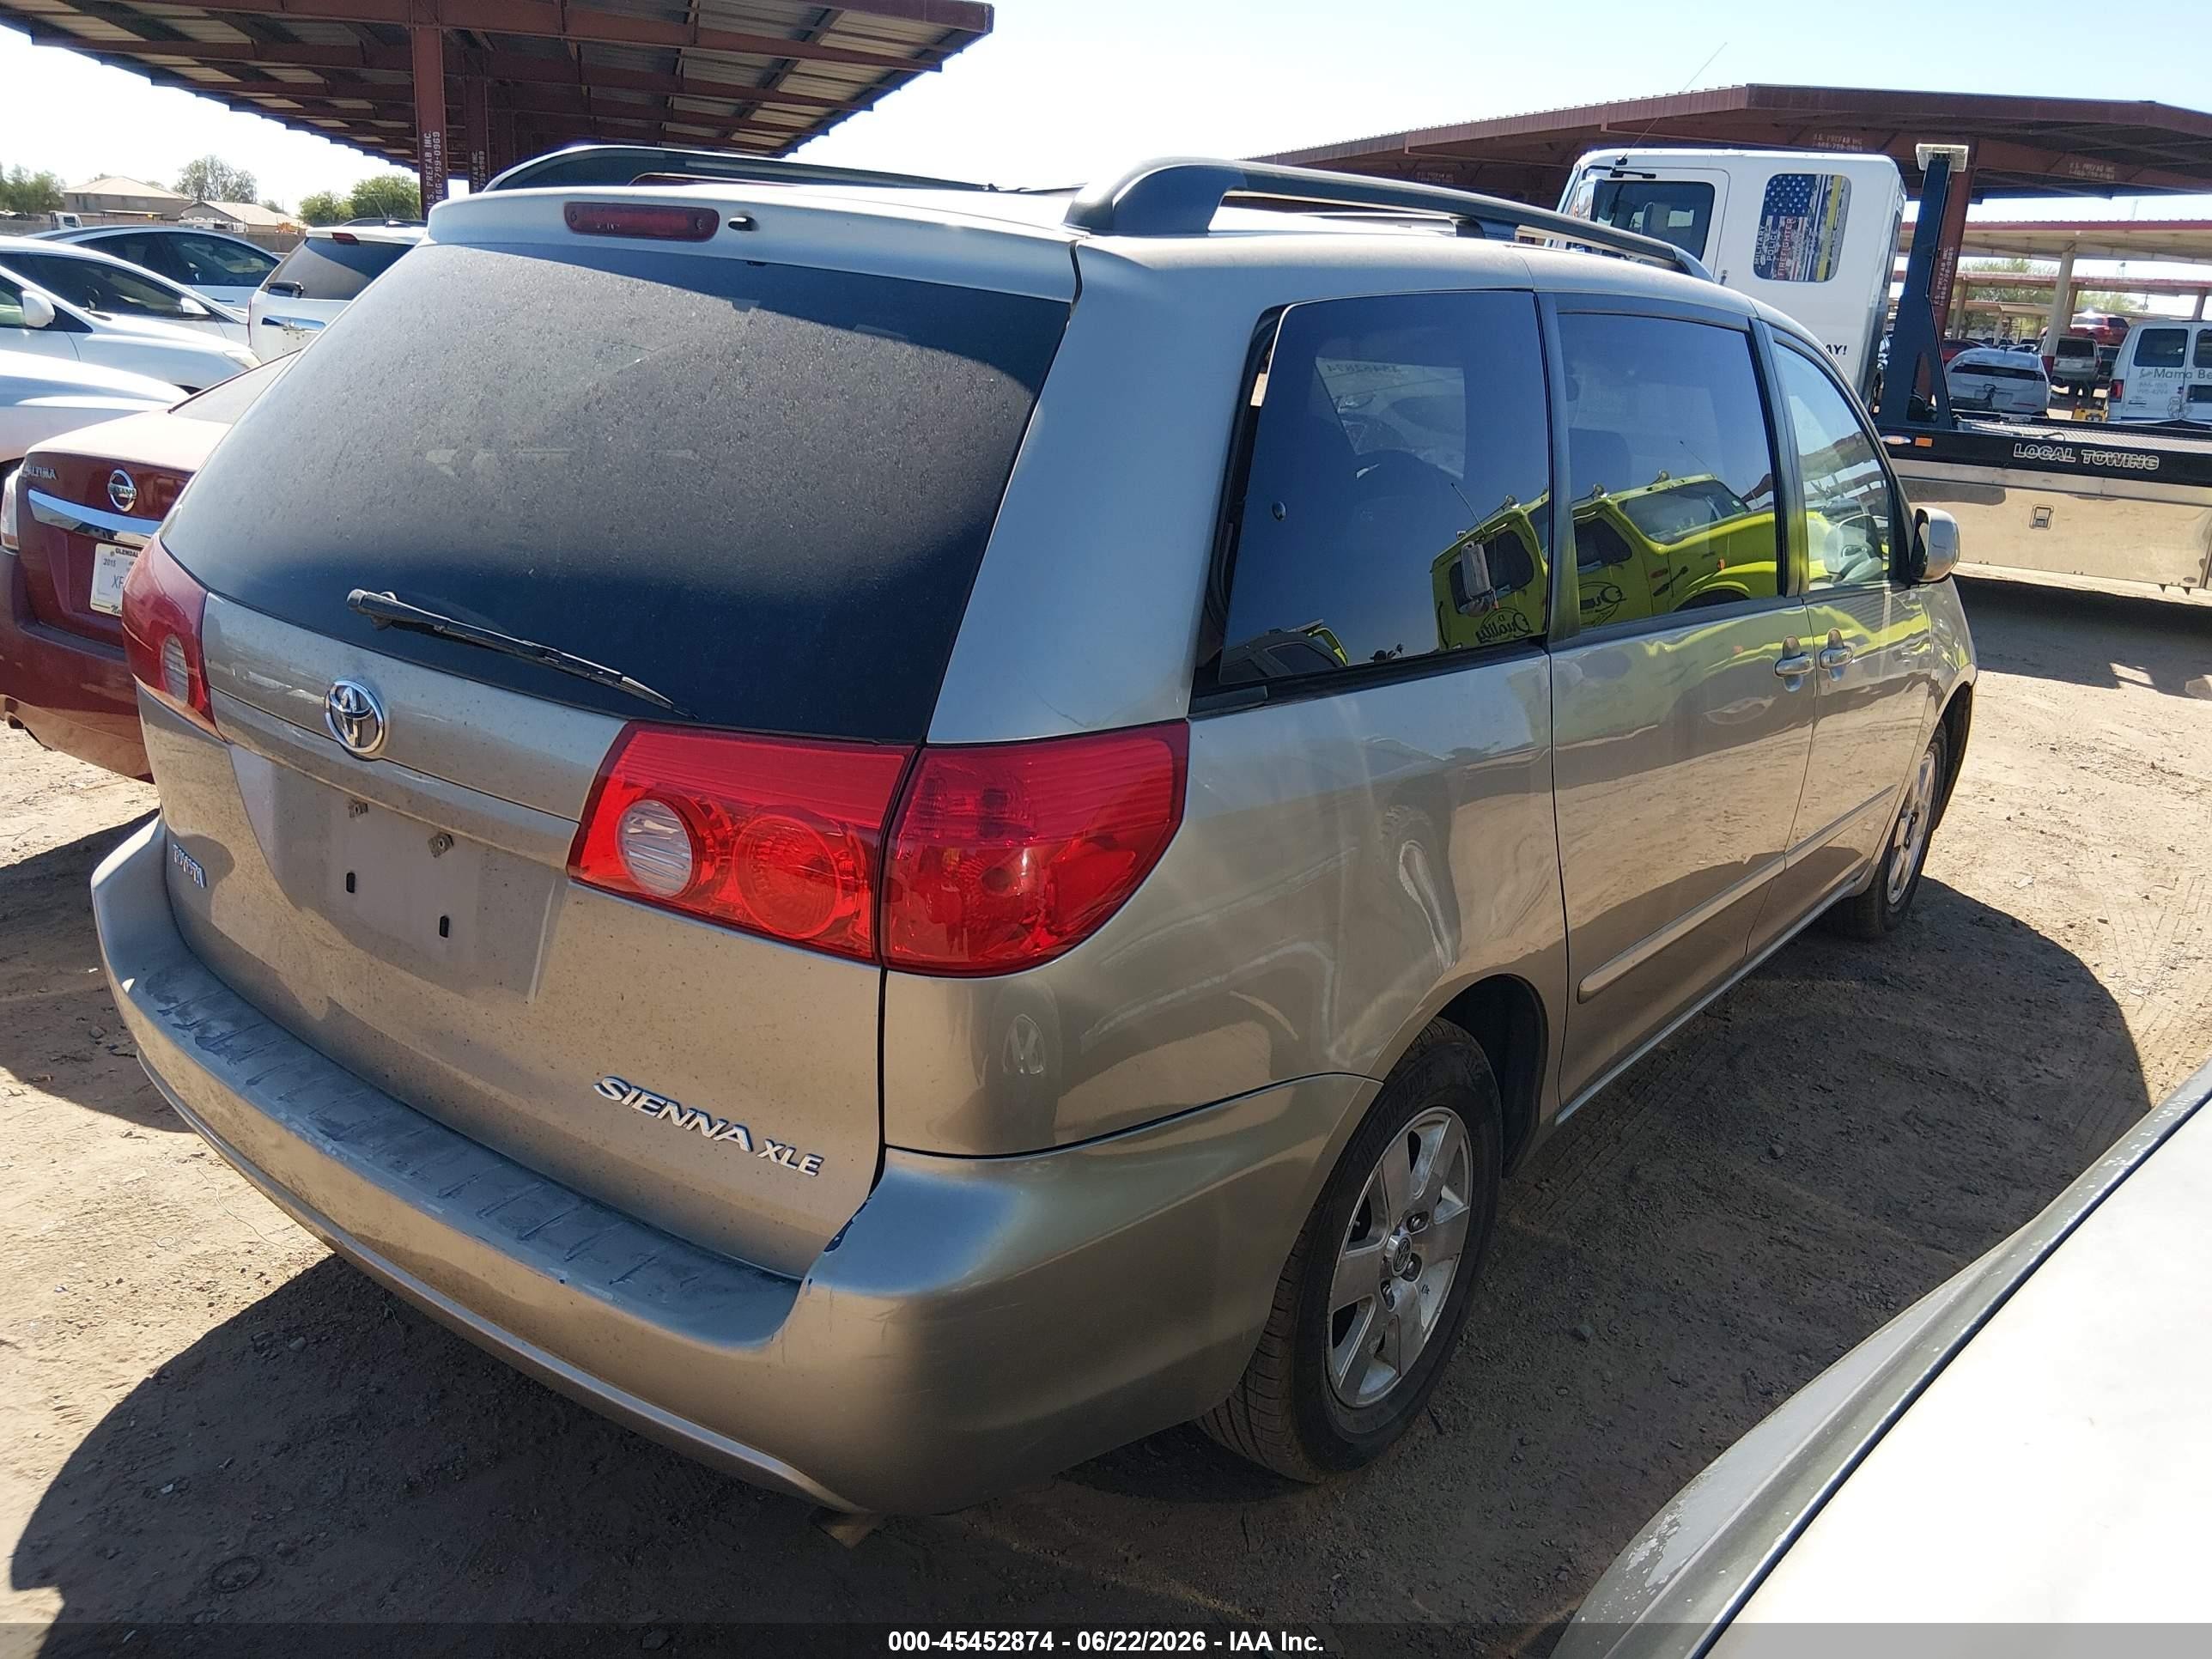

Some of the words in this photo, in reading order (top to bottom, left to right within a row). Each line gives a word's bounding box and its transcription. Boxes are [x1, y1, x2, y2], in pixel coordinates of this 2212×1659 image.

[423, 131, 432, 148] INC.
[424, 152, 434, 187] PREFAB
[432, 131, 443, 200] 866-799-0969
[1753, 224, 1765, 265] MILITARY
[1766, 228, 1778, 262] POLICE
[1778, 217, 1796, 276] FIREFIGHTER
[1826, 343, 1848, 356] AY!
[2153, 368, 2193, 379] Mama
[2197, 369, 2212, 379] Be
[2013, 443, 2076, 463] LOCAL
[2081, 450, 2160, 471] TOWING
[115, 548, 138, 557] GLENDAL
[112, 574, 125, 589] XF
[173, 843, 206, 889] TOYOTA
[593, 1076, 754, 1153] SIENNA
[757, 1139, 824, 1177] XLE
